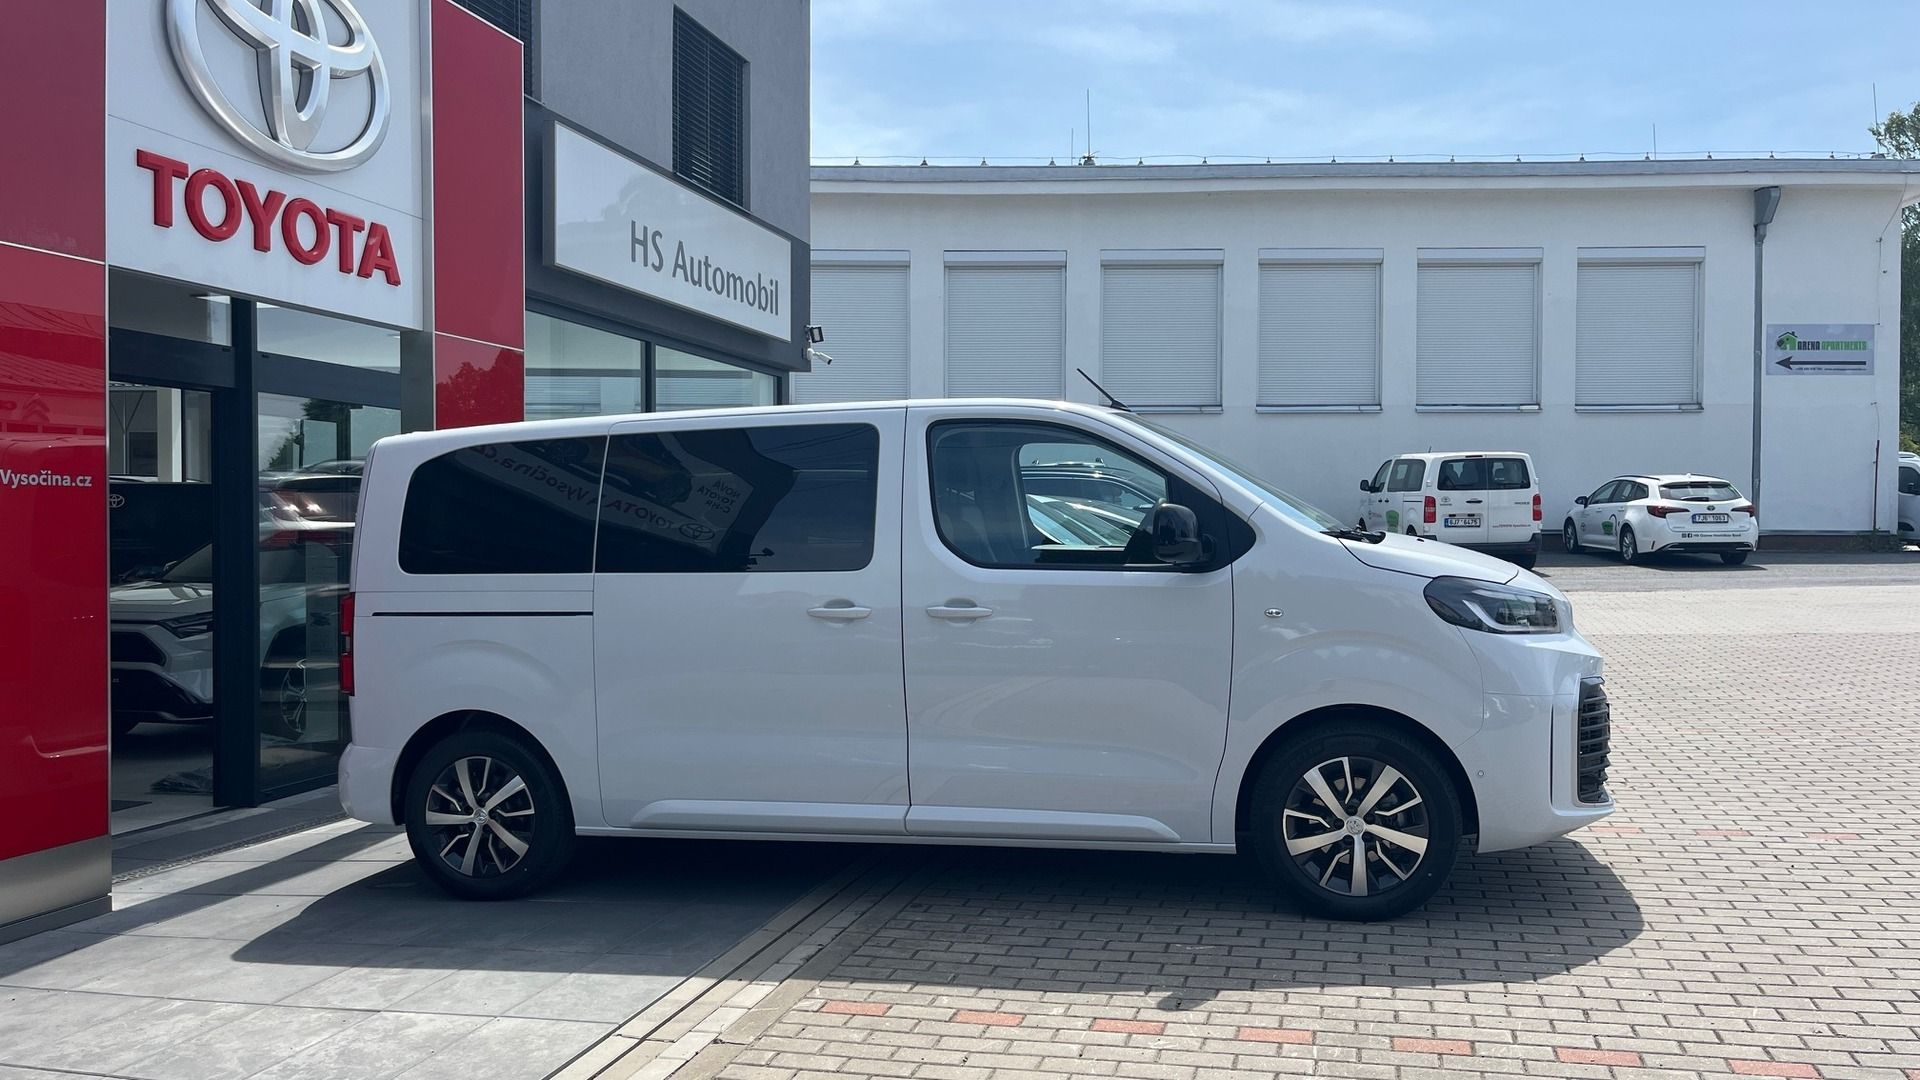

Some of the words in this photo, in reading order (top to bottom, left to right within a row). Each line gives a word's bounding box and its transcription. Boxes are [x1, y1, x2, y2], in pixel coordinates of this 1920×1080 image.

[137, 149, 401, 287] TOYOTA
[630, 219, 664, 272] HS
[672, 240, 779, 316] Automobil
[1822, 341, 1867, 351] APARTMENTS
[0, 469, 92, 489] Vysočina.cz
